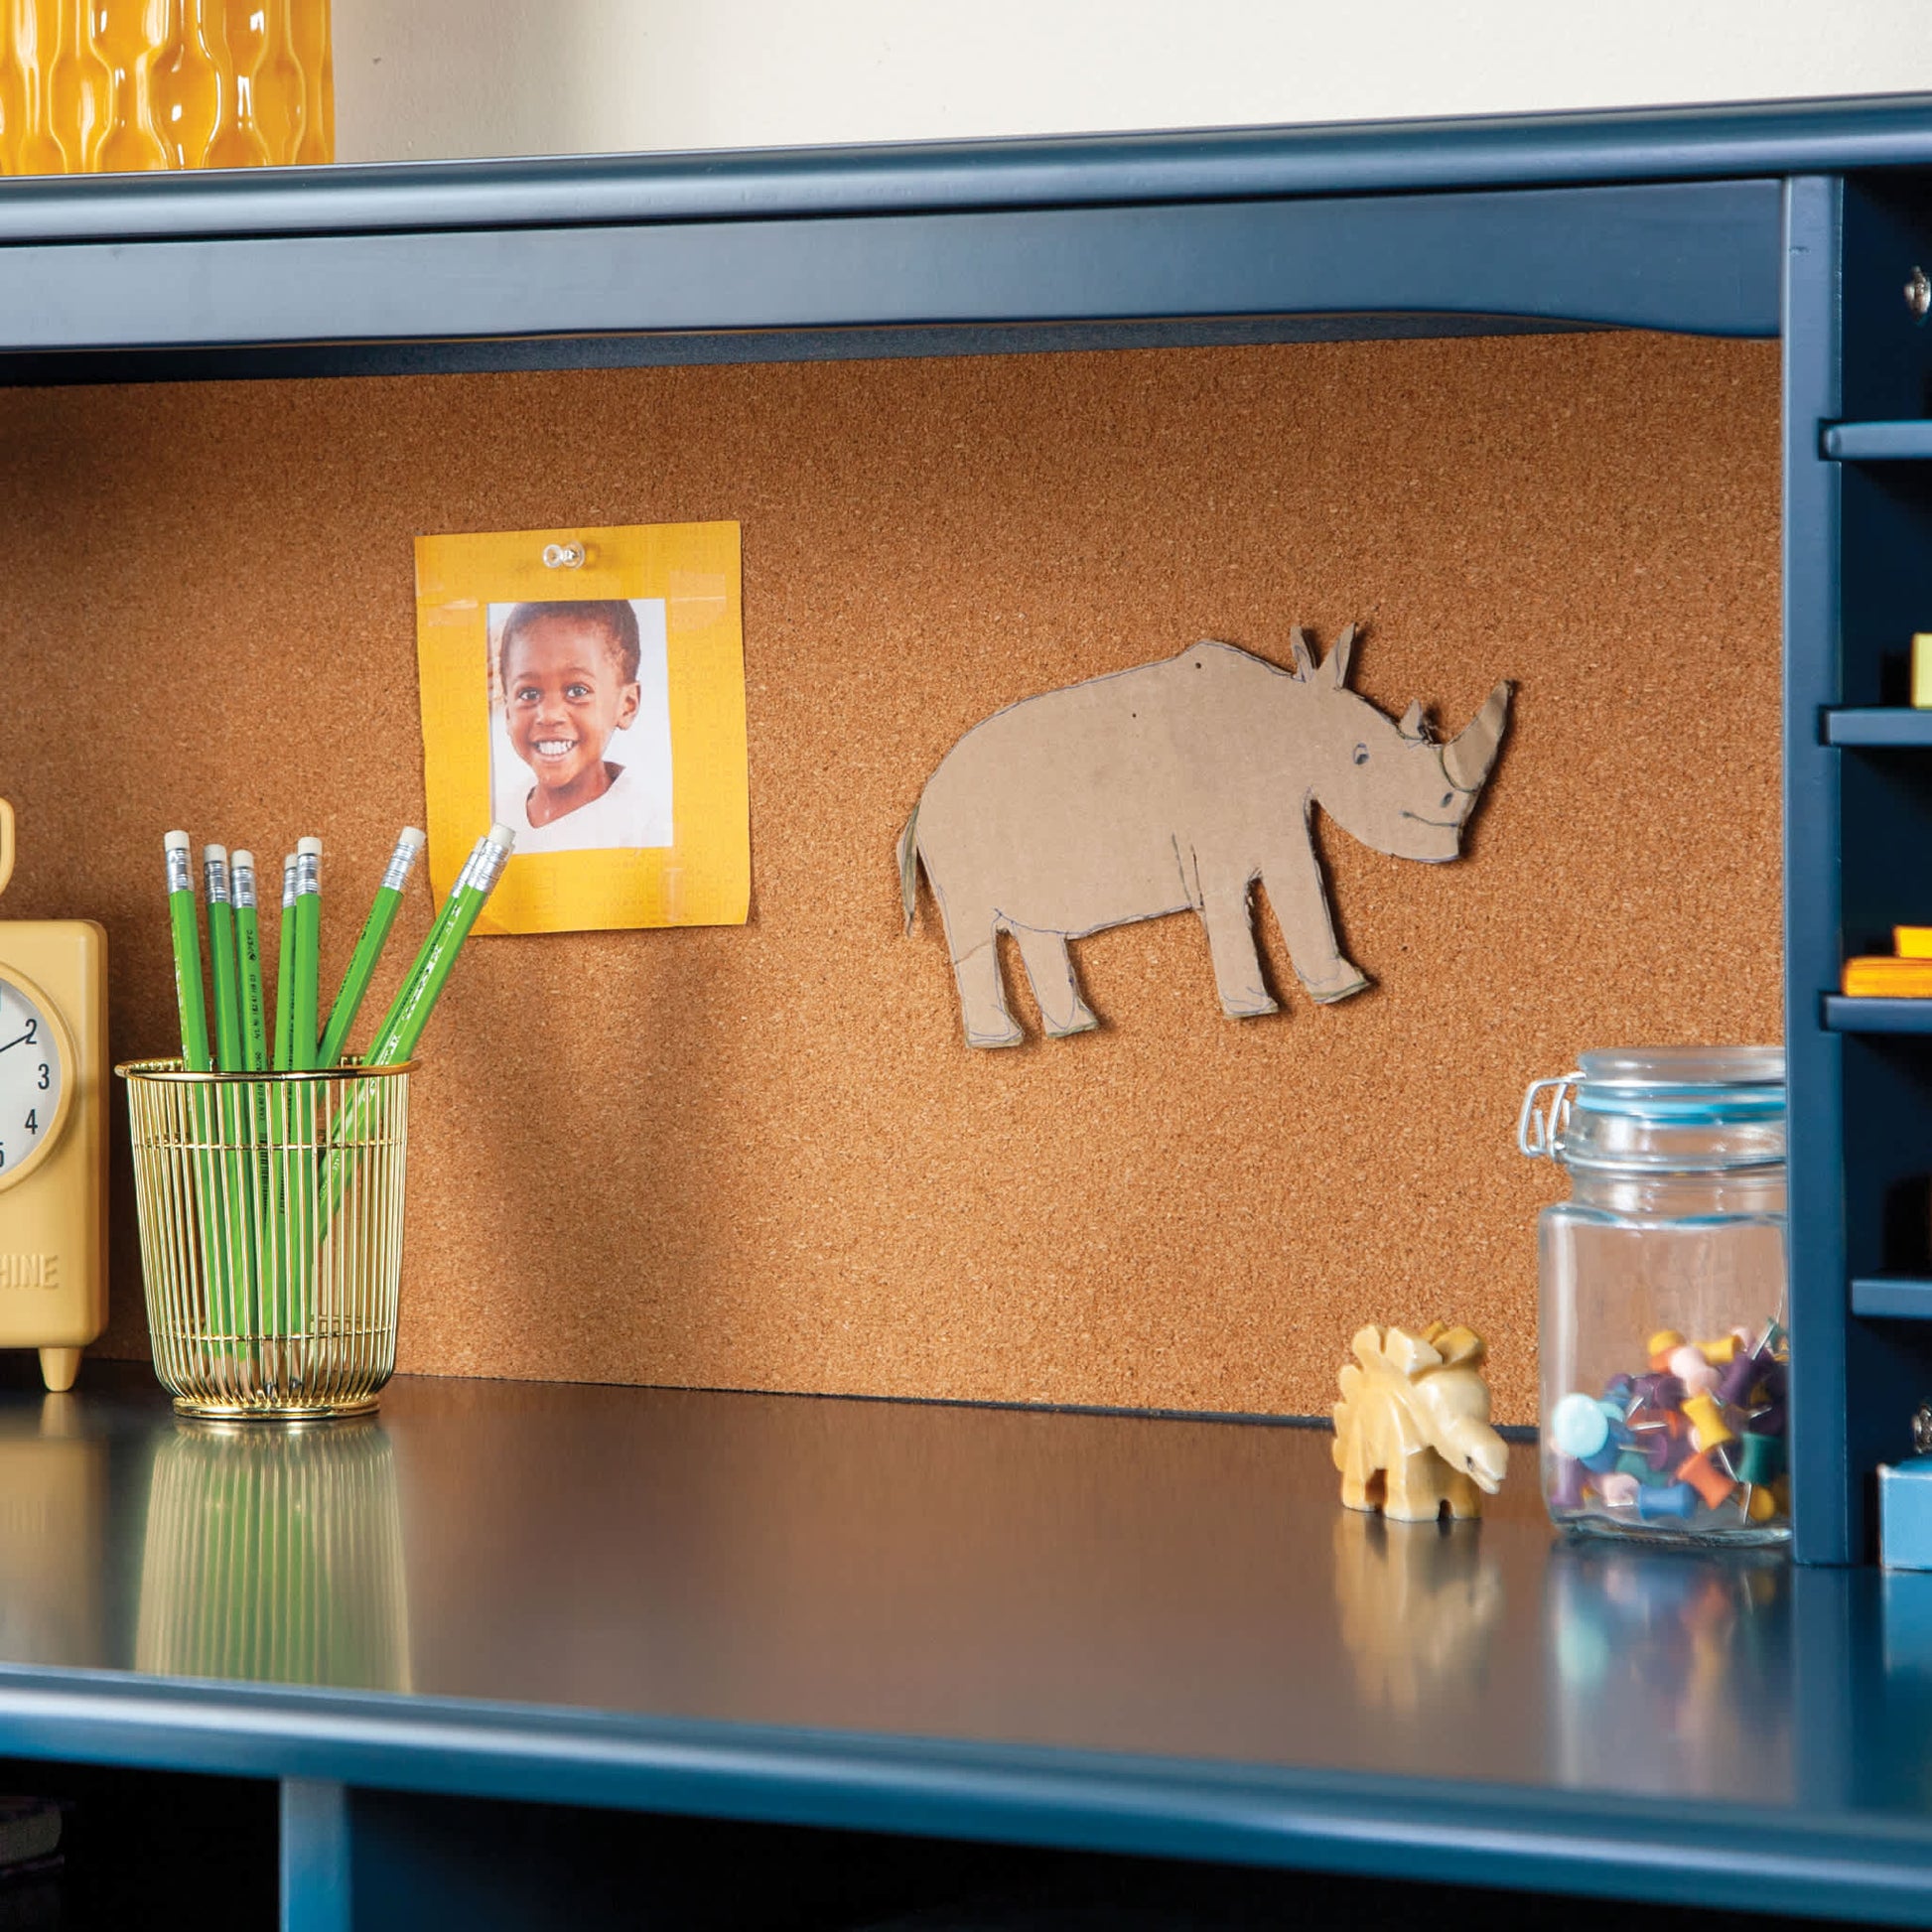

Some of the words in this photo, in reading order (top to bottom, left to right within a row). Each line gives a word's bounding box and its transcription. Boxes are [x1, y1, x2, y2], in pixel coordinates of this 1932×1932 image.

[25, 1019, 37, 1044] 2
[38, 1063, 50, 1090] 3
[25, 1108, 38, 1135] 4
